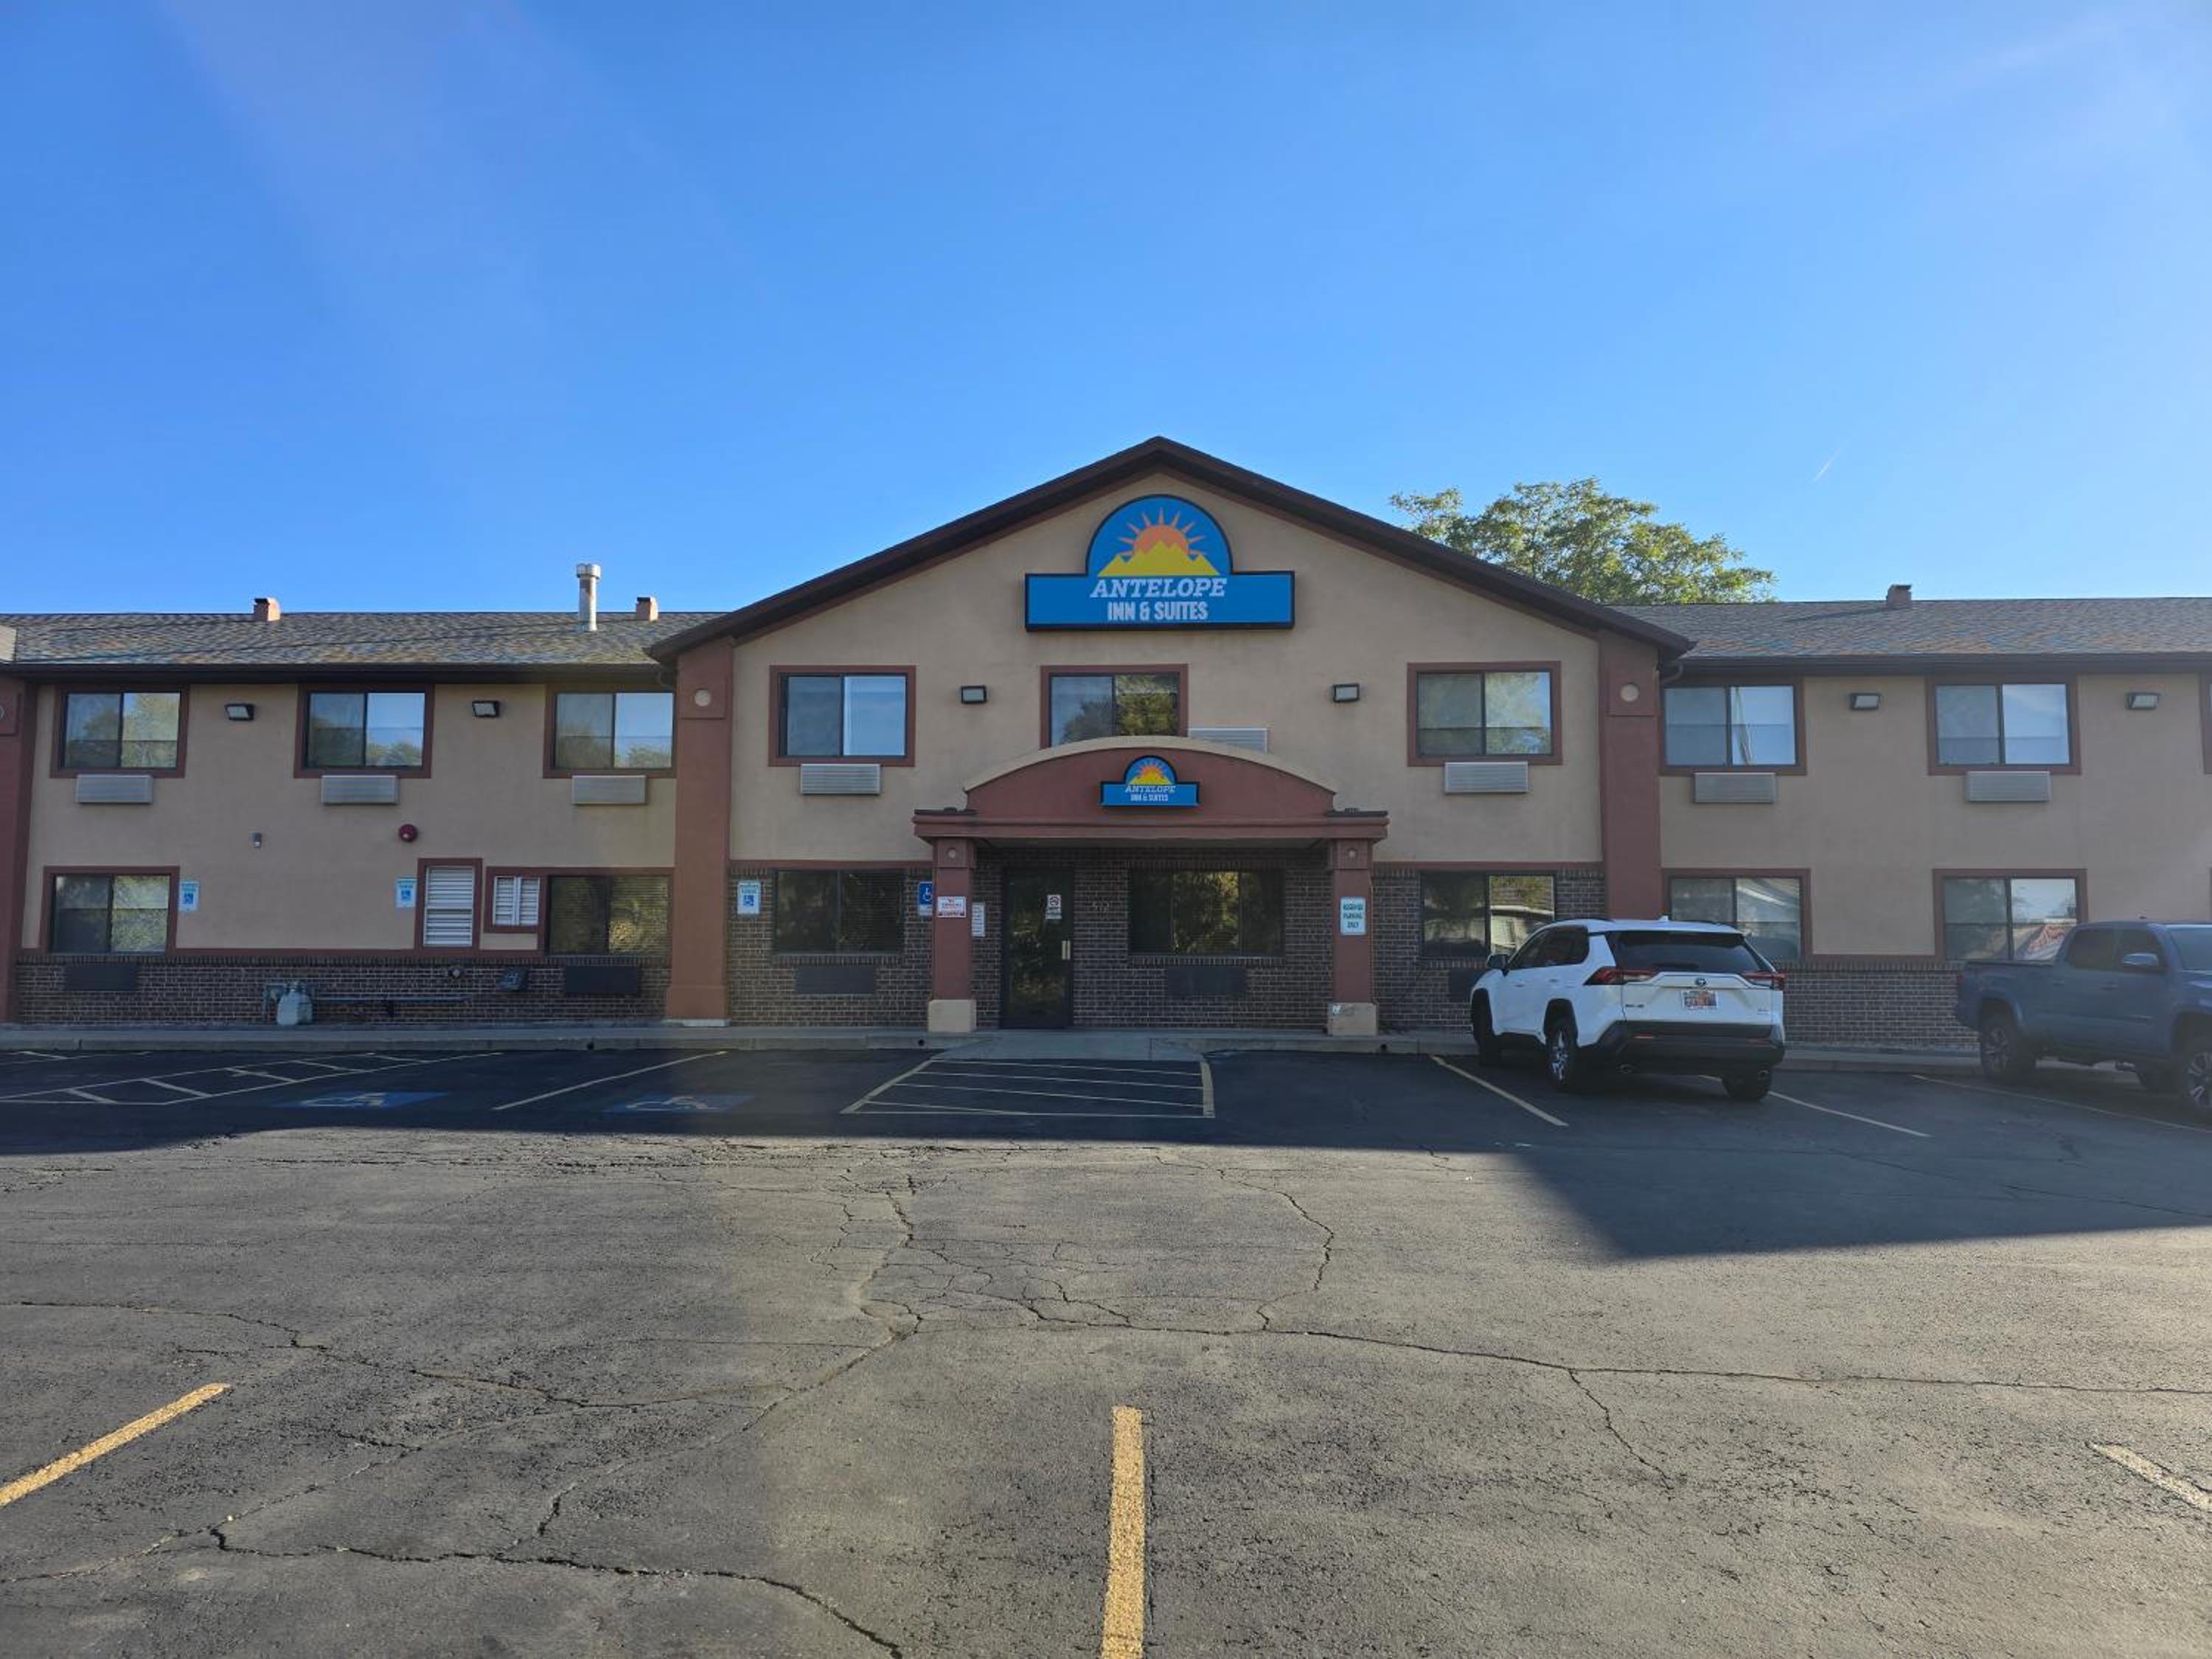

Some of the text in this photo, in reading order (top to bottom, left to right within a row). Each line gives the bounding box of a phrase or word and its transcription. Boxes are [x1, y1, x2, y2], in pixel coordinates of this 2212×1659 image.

[1089, 578, 1227, 598] ANTELOPE
[1107, 601, 1208, 622] INN & SUITES
[1124, 785, 1176, 793] ANTELOPE
